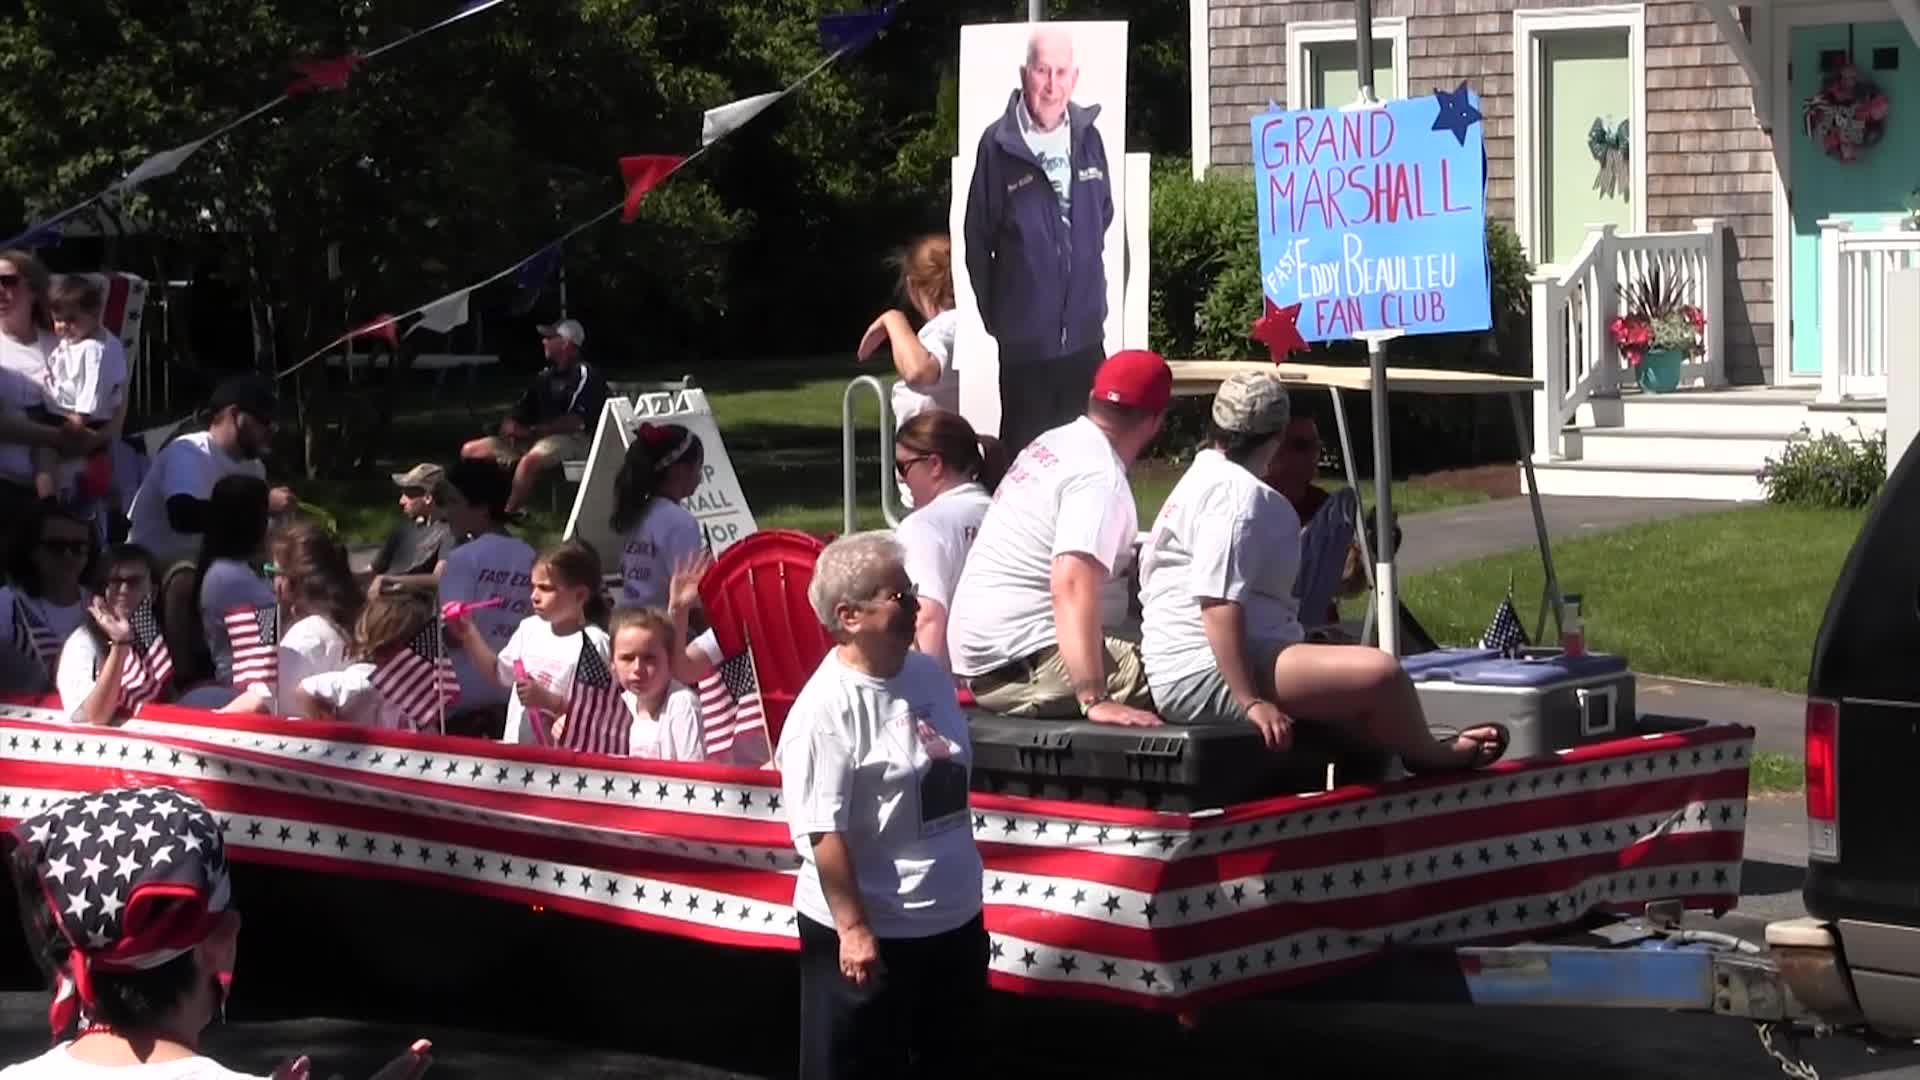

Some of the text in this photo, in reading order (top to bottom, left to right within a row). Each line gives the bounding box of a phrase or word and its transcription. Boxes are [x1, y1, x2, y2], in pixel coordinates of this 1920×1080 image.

[1261, 110, 1395, 169] GRAND
[1269, 158, 1473, 235] MARSHALL
[1343, 232, 1457, 297] BEAULIEU
[1315, 291, 1446, 336] FAN CLUB
